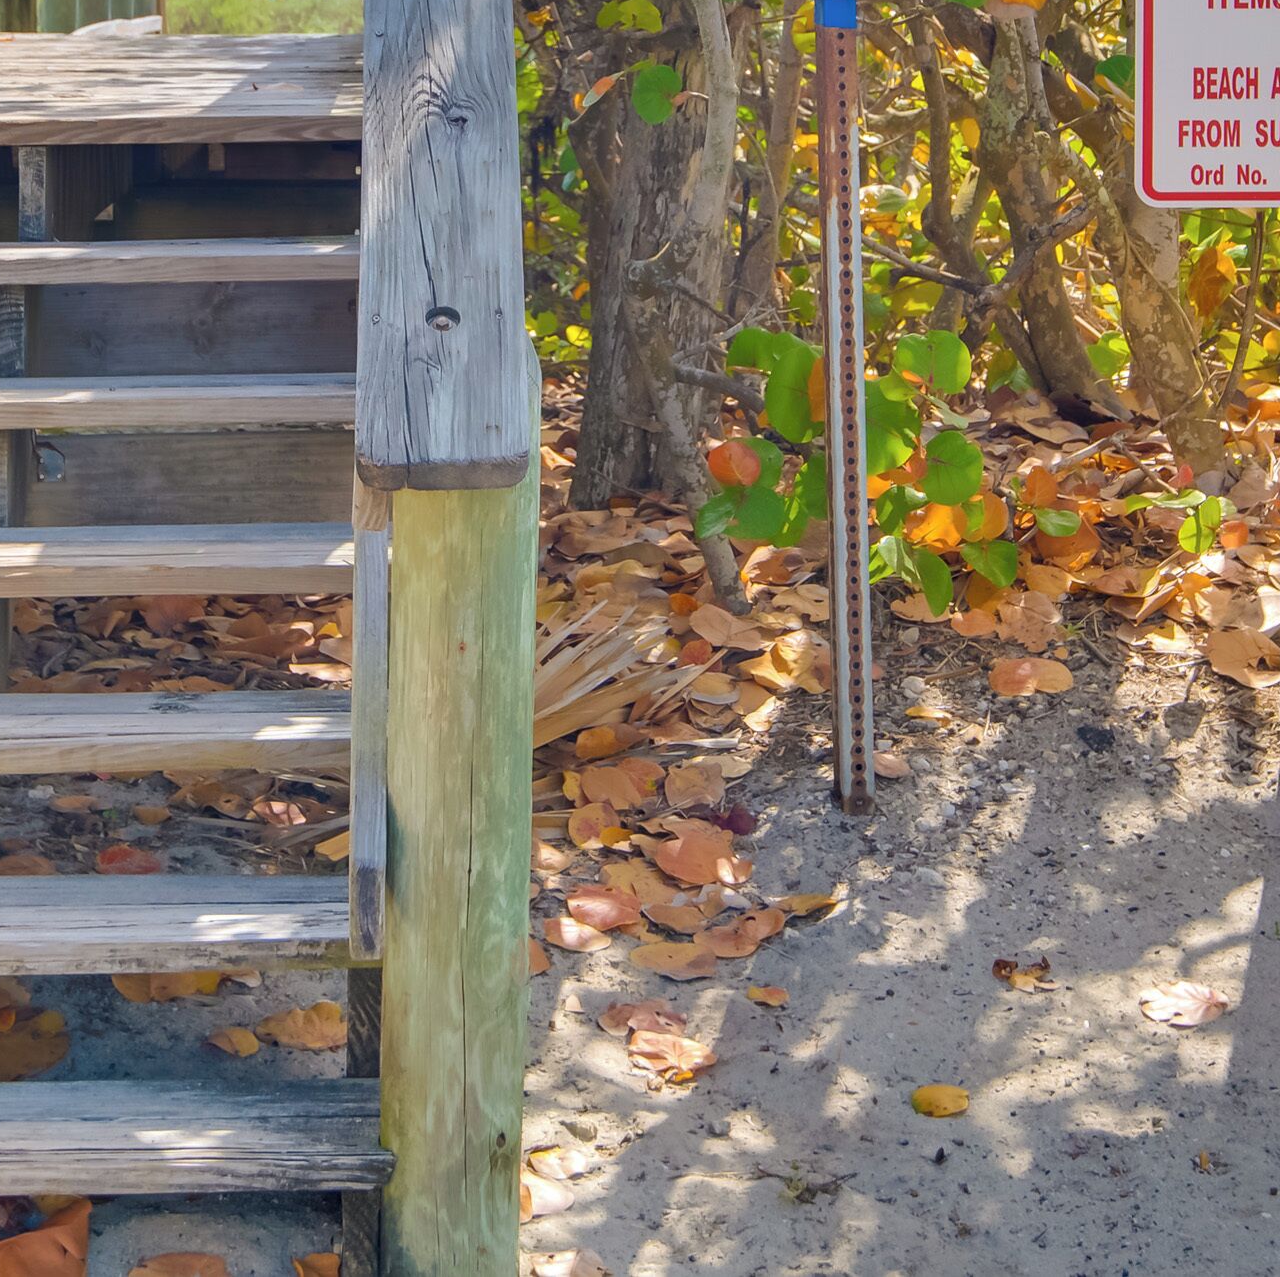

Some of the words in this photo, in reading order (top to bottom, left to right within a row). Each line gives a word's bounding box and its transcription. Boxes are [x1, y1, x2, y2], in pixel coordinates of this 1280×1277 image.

[1193, 67, 1258, 99] BEACH
[1178, 120, 1239, 146] FROM
[1191, 164, 1223, 185] Ord
[1237, 164, 1266, 184] No.
